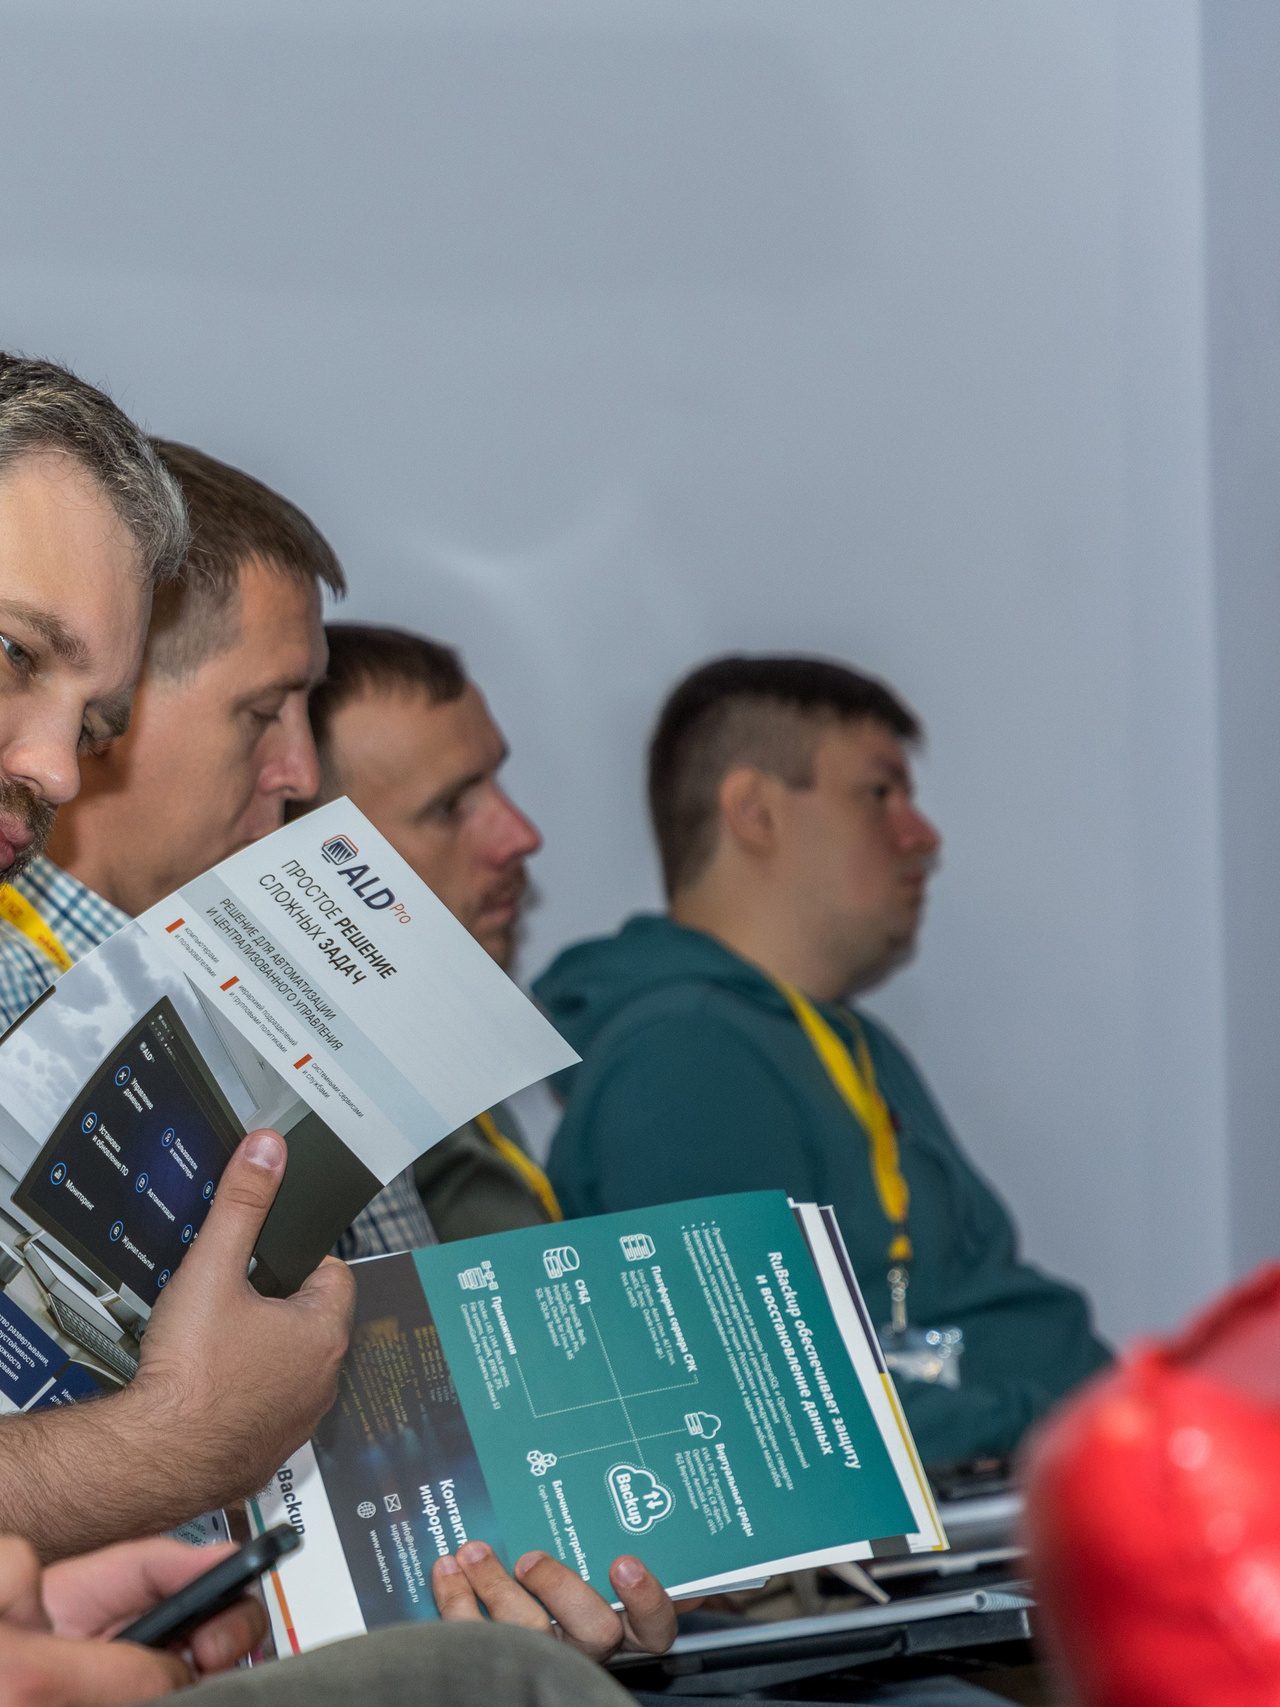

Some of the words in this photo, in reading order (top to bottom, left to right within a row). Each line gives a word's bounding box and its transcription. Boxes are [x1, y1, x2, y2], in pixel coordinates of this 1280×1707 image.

[281, 859, 343, 920] ПРОСТОЕ
[334, 917, 397, 979] РЕШЕНИЕ
[337, 864, 396, 910] ALD
[389, 903, 412, 924] Pro
[178, 937, 217, 978] пользователями
[184, 927, 220, 964] компьютерами
[220, 899, 259, 937] РЕШЕНИЕ
[252, 936, 275, 955] ДЛЯ
[270, 953, 337, 1021] АВТОМАТИЗАЦИИ
[259, 874, 326, 941] СЛОЖНЫХ
[318, 938, 367, 984] ЗАДАЧ
[206, 907, 218, 917] И
[213, 915, 297, 1002] ЦЕНТРАЛИЗОВАННОГО
[293, 999, 344, 1051] УПРАВЛЕНИЯ
[233, 996, 261, 1026] групповыми
[260, 1023, 288, 1053] политиками
[239, 985, 265, 1012] иерархией
[262, 1008, 298, 1047] подразделений
[305, 1073, 330, 1099] службами
[311, 1062, 340, 1093] системными
[338, 1090, 364, 1118] сервисами
[120, 1164, 129, 1177] ПО
[575, 1279, 591, 1305] СУБД
[756, 1275, 768, 1284] и
[7, 1323, 49, 1368] развертывания,
[491, 1296, 517, 1355] Приложения
[651, 1265, 675, 1316] Платформа
[670, 1317, 688, 1353] сервера
[683, 1354, 698, 1372] СРК
[760, 1287, 811, 1397] восстановление
[494, 1349, 504, 1365] Block
[768, 1252, 801, 1317] RuBackup
[794, 1320, 840, 1414] обеспечивает
[832, 1417, 861, 1469] защиту
[760, 1352, 780, 1390] PostgreSQL
[777, 1396, 796, 1436] OpenSource
[790, 1437, 810, 1469] решений
[765, 1398, 780, 1424] данных
[800, 1400, 834, 1455] данных
[419, 1485, 449, 1556] информа
[616, 1473, 642, 1525] Backup
[715, 1443, 743, 1505] Виртуальные
[736, 1506, 754, 1537] среды
[538, 1484, 548, 1501] Ceph
[549, 1519, 559, 1536] block
[554, 1537, 566, 1560] devices
[552, 1480, 572, 1524] Блочные
[564, 1525, 590, 1581] устройства
[370, 1530, 393, 1592] www.rubackup.ru
[390, 1524, 419, 1603] support@rubackup.ru
[401, 1521, 425, 1586] info@rubackup.ru
